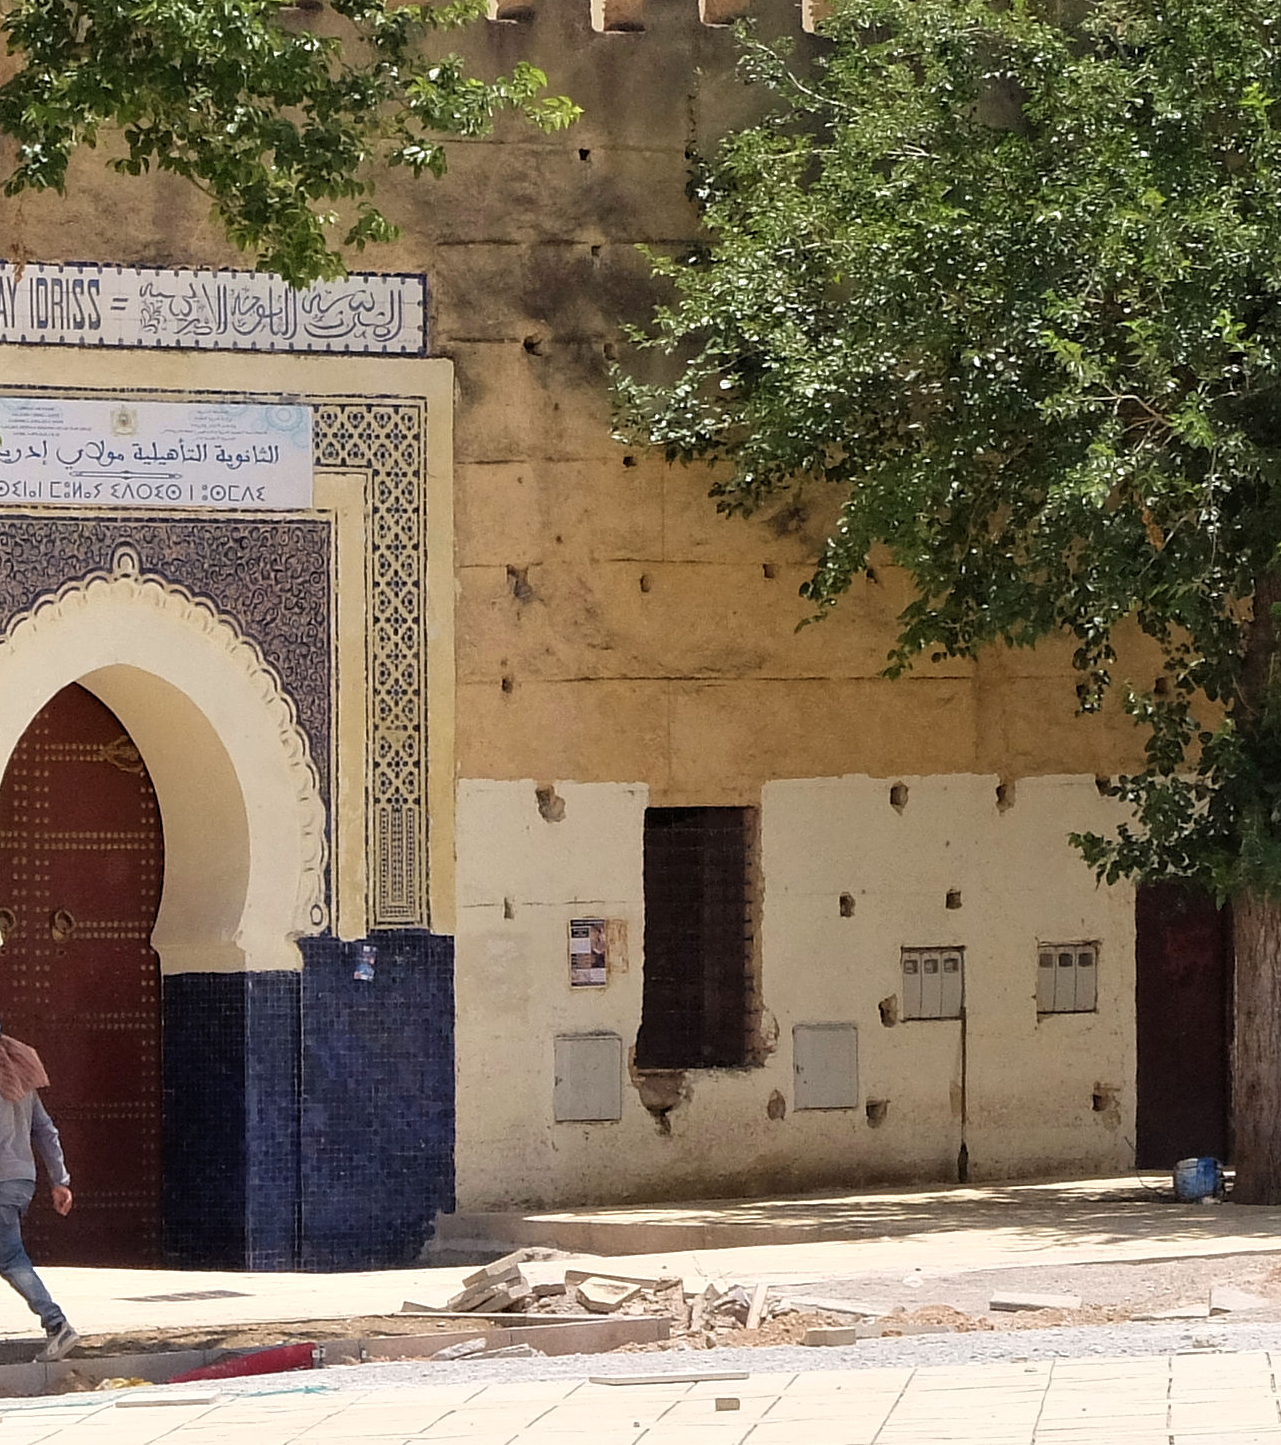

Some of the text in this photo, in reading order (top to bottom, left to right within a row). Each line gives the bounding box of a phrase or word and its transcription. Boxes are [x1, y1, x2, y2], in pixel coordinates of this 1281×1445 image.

[29, 277, 101, 331] IDRISS
[56, 440, 124, 470] مولاي
[132, 438, 208, 466] التأهيلية
[215, 444, 279, 470] الثانوية
